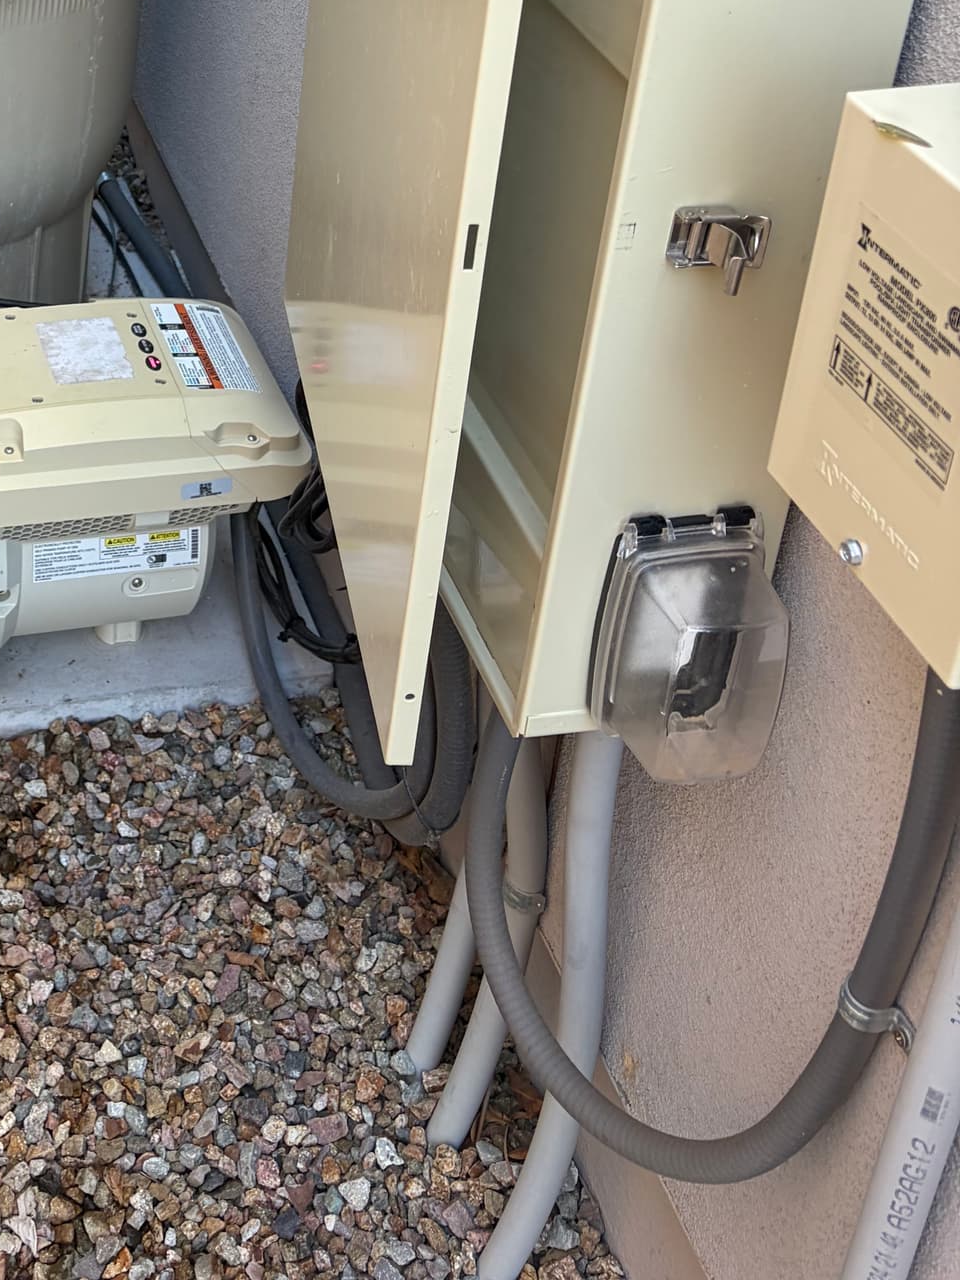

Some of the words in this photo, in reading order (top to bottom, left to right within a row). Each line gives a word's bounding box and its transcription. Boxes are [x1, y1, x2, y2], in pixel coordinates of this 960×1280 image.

[857, 222, 922, 290] INTERMATIC
[859, 259, 871, 273] LOW
[871, 269, 893, 294] VOLTAGE
[890, 275, 914, 301] MODEL
[911, 315, 951, 358] TRANSFORMER
[820, 439, 920, 571] INTERMATIC
[113, 536, 136, 545] CAUTION
[887, 1137, 936, 1231] A52AG12
